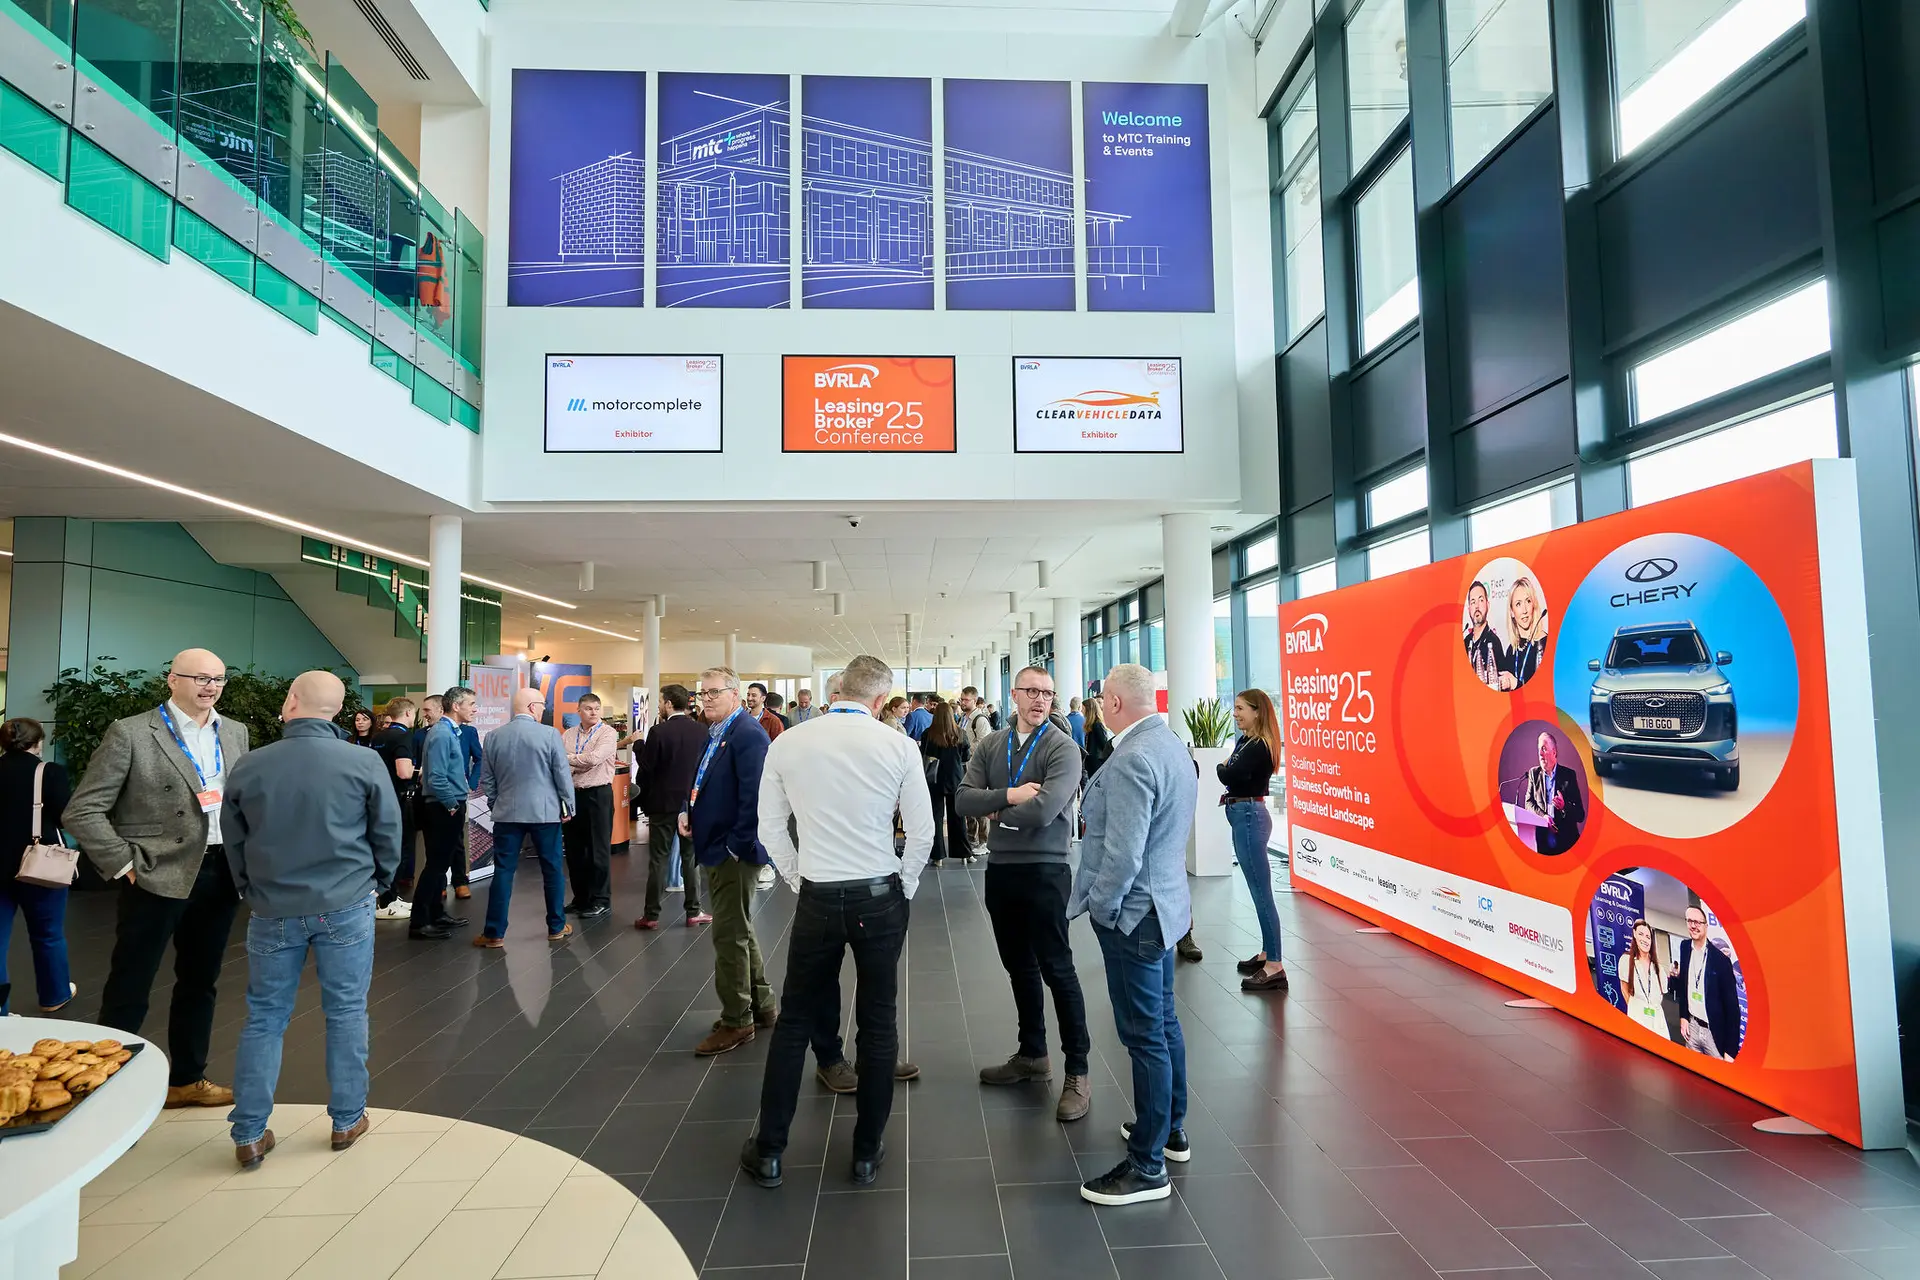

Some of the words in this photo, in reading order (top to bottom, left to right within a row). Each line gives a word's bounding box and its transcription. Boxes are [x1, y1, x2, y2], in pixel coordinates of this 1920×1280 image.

[1102, 111, 1182, 127] Welcome
[731, 134, 756, 145] progress
[1102, 133, 1115, 143] to
[1117, 133, 1143, 143] MTC
[1145, 133, 1191, 147] Training
[692, 139, 724, 161] mtc
[1103, 145, 1112, 156] &
[1114, 146, 1154, 156] Events
[705, 360, 717, 369] 25
[1166, 363, 1177, 371] 25
[814, 373, 872, 388] BVRLA
[592, 398, 702, 413] motorcomplete
[815, 397, 884, 417] Leasing
[885, 401, 924, 429] 25
[815, 413, 874, 429] Broker
[1036, 410, 1162, 420] CLEARVEHICLEDATA
[615, 430, 653, 438] Exhibitor
[814, 428, 924, 445] Conference
[1081, 430, 1118, 439] Exhibitor
[1610, 582, 1698, 608] CHERY
[1285, 627, 1324, 654] BVRLA
[474, 672, 509, 698] HIVE
[1287, 668, 1339, 701] Leasing
[1339, 671, 1375, 724] 25
[1288, 695, 1332, 720] Broker
[1290, 720, 1376, 753] Conference
[1291, 755, 1316, 775] Scaling
[1317, 759, 1341, 776] Smart:
[1292, 775, 1322, 794] Business
[1323, 781, 1352, 800] Growth
[1354, 786, 1363, 803] in
[1364, 793, 1371, 805] a
[1293, 795, 1328, 817] Regulated
[1329, 804, 1375, 830] Landscape
[1296, 851, 1322, 867] CHERY
[1377, 876, 1397, 894] leasing
[1600, 882, 1630, 902] BVRLA
[1477, 896, 1493, 912] iCR
[1508, 922, 1564, 952] BROKERNEWS
